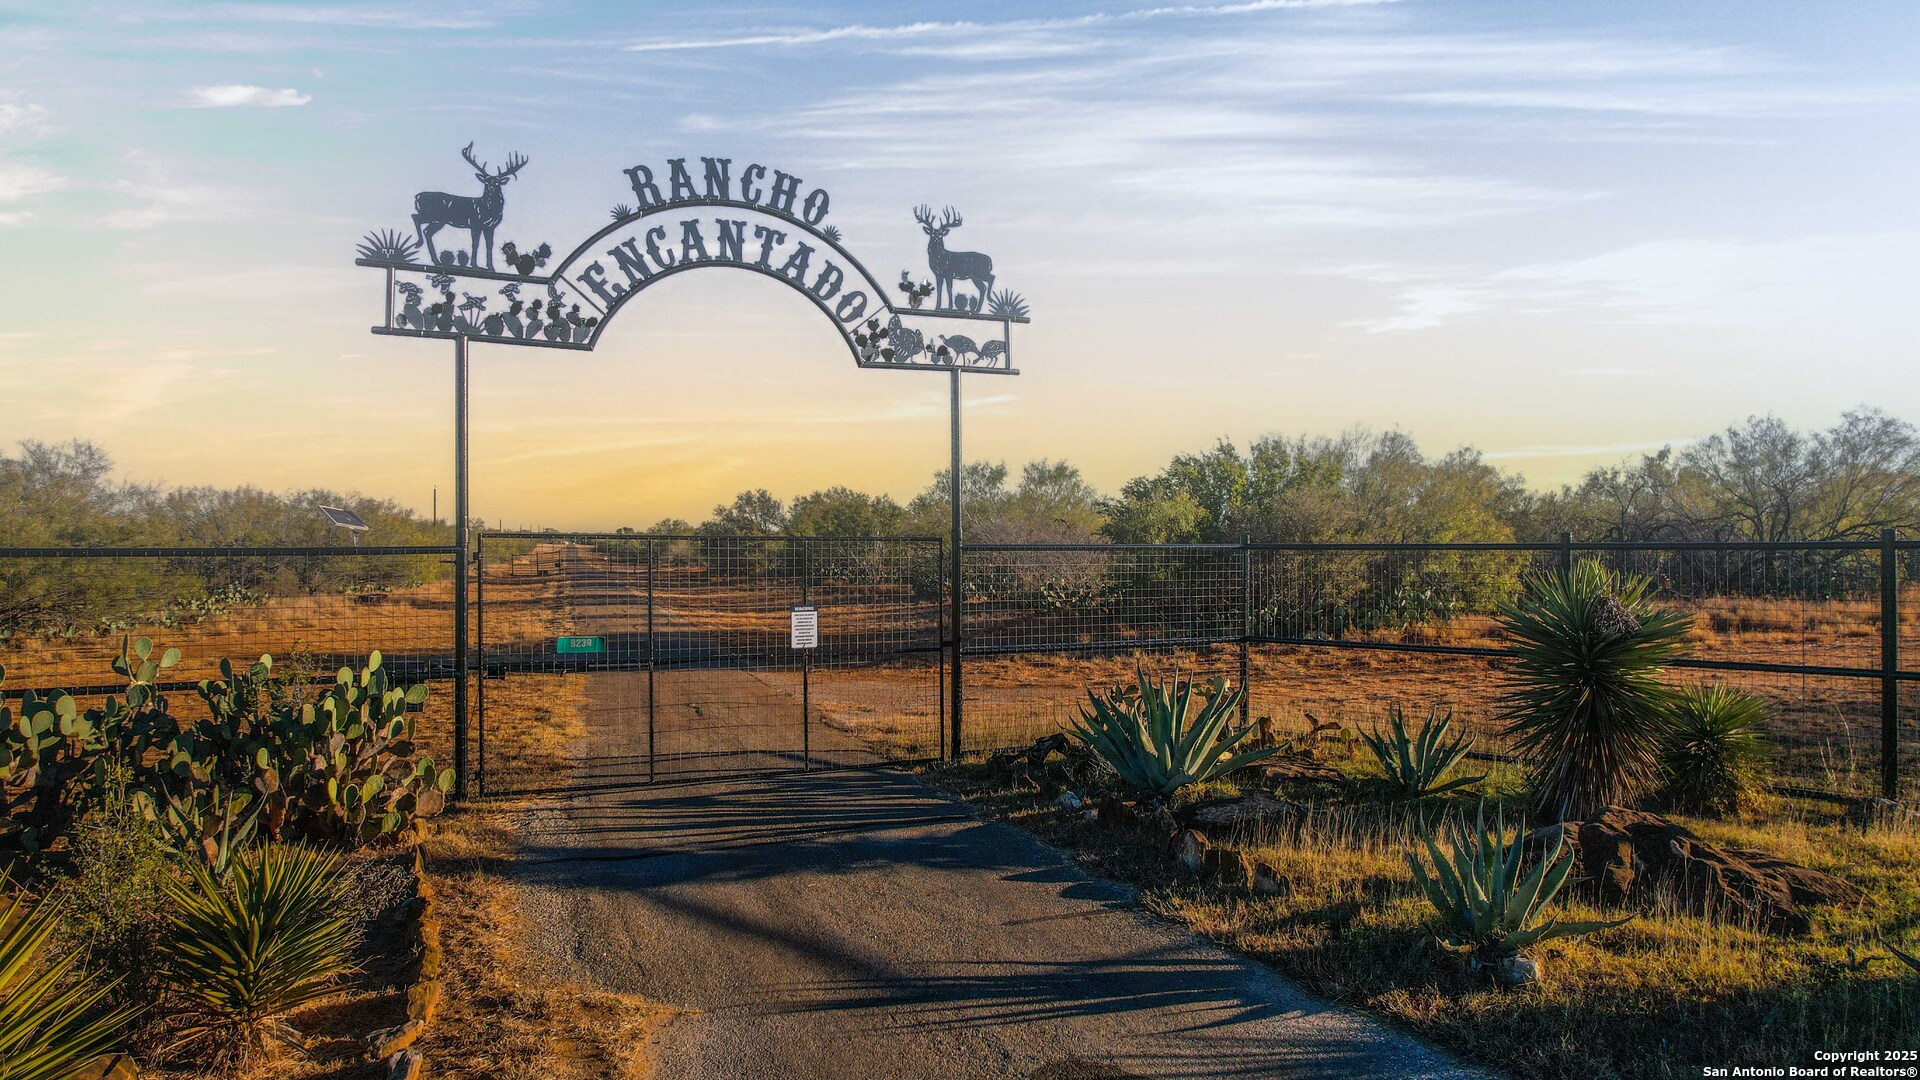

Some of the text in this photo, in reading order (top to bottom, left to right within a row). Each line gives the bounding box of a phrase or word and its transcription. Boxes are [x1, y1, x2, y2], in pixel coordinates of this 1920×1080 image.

[623, 156, 830, 226] RANCHO
[576, 218, 868, 324] ENCANTADO
[570, 639, 592, 648] 9239
